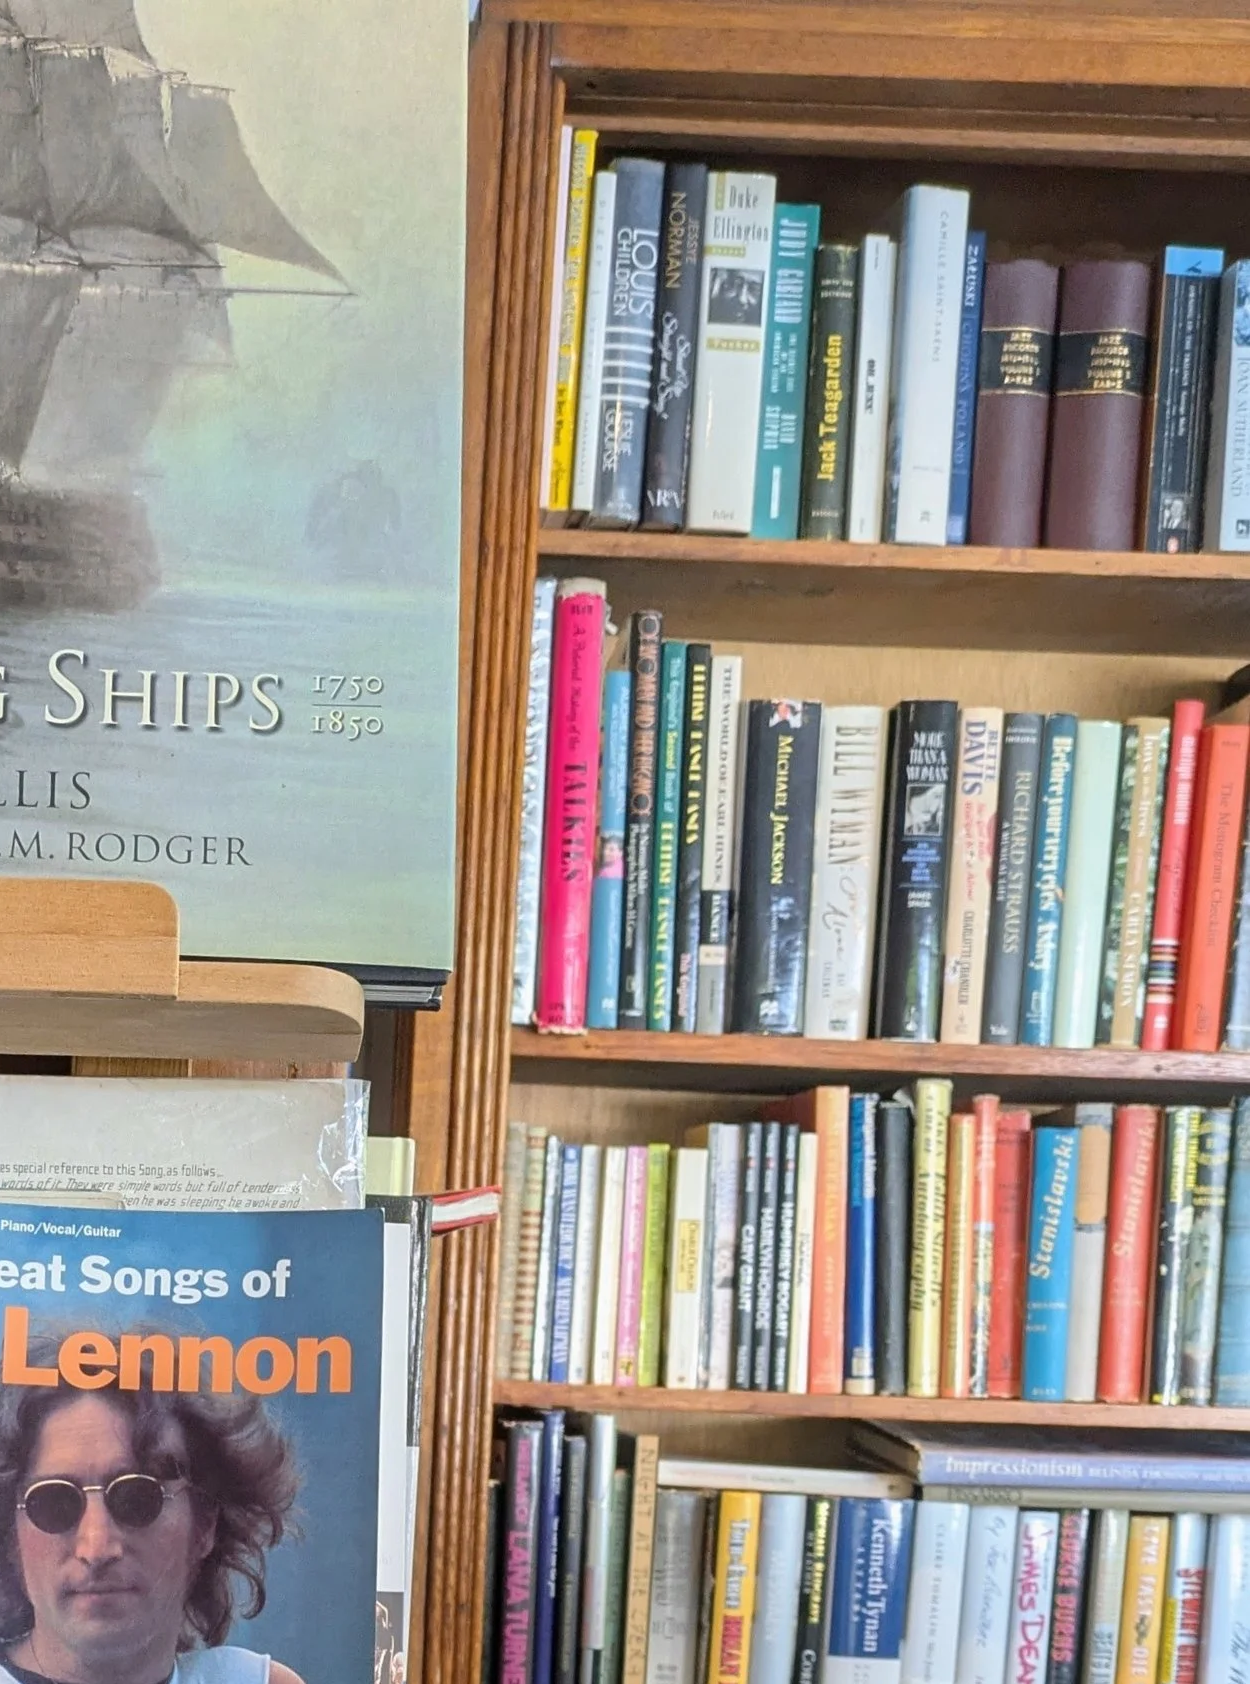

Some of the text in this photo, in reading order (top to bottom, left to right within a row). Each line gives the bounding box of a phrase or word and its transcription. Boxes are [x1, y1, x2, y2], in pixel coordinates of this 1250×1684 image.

[712, 215, 770, 243] Ellington
[728, 184, 759, 209] Duke
[612, 227, 632, 316] CHILDREN
[665, 192, 701, 289] JESSYE NORMAN
[777, 218, 808, 258] JUDY
[816, 333, 843, 481] Jack Teagarden
[953, 399, 969, 464] POLAND
[1231, 399, 1248, 499] SUTHERLAND
[44, 648, 284, 737] SHIPS
[310, 672, 384, 701] 1750
[310, 708, 384, 740] 1850
[831, 725, 879, 777] BILL
[961, 720, 998, 797] BETTE DAVIS
[560, 761, 589, 883] TALKIES
[712, 705, 733, 884] WORLD HINES
[770, 734, 795, 885] MICHAEL JACKSON
[66, 830, 253, 867] RODGER
[1002, 770, 1034, 955] RICHARD STRAUSS
[1211, 811, 1230, 883] Monogram
[12, 1162, 47, 1177] special
[49, 1162, 101, 1176] reference
[116, 1163, 136, 1177] this
[117, 1180, 182, 1195] simple words
[180, 1195, 226, 1211] sleeping
[931, 1171, 947, 1223] Edith
[0, 1218, 122, 1240] Piano/Vocal/Guitar
[911, 1169, 931, 1313] Autobiography
[1029, 1133, 1076, 1281] Stanislavski
[78, 1253, 225, 1306] Songs
[240, 1257, 291, 1299] of
[738, 1224, 754, 1313] CARY GRANT
[756, 1206, 774, 1330] MARILYN MONROE
[775, 1201, 794, 1338] HUMPHREY BOGART
[3, 1304, 352, 1395] Lennon
[945, 1455, 1083, 1480] Impressionism
[632, 1448, 657, 1602] NIGHT THE
[1055, 1518, 1076, 1588] GEORGE
[1142, 1523, 1161, 1565] LIVE
[504, 1530, 531, 1605] LANA
[862, 1518, 891, 1653] Kenneth Tynan
[1017, 1522, 1055, 1613] JAMES
[1138, 1573, 1156, 1616] FAST
[1177, 1568, 1207, 1638] STEWART
[1050, 1592, 1074, 1661] BURNS
[1132, 1646, 1150, 1676] DIE
